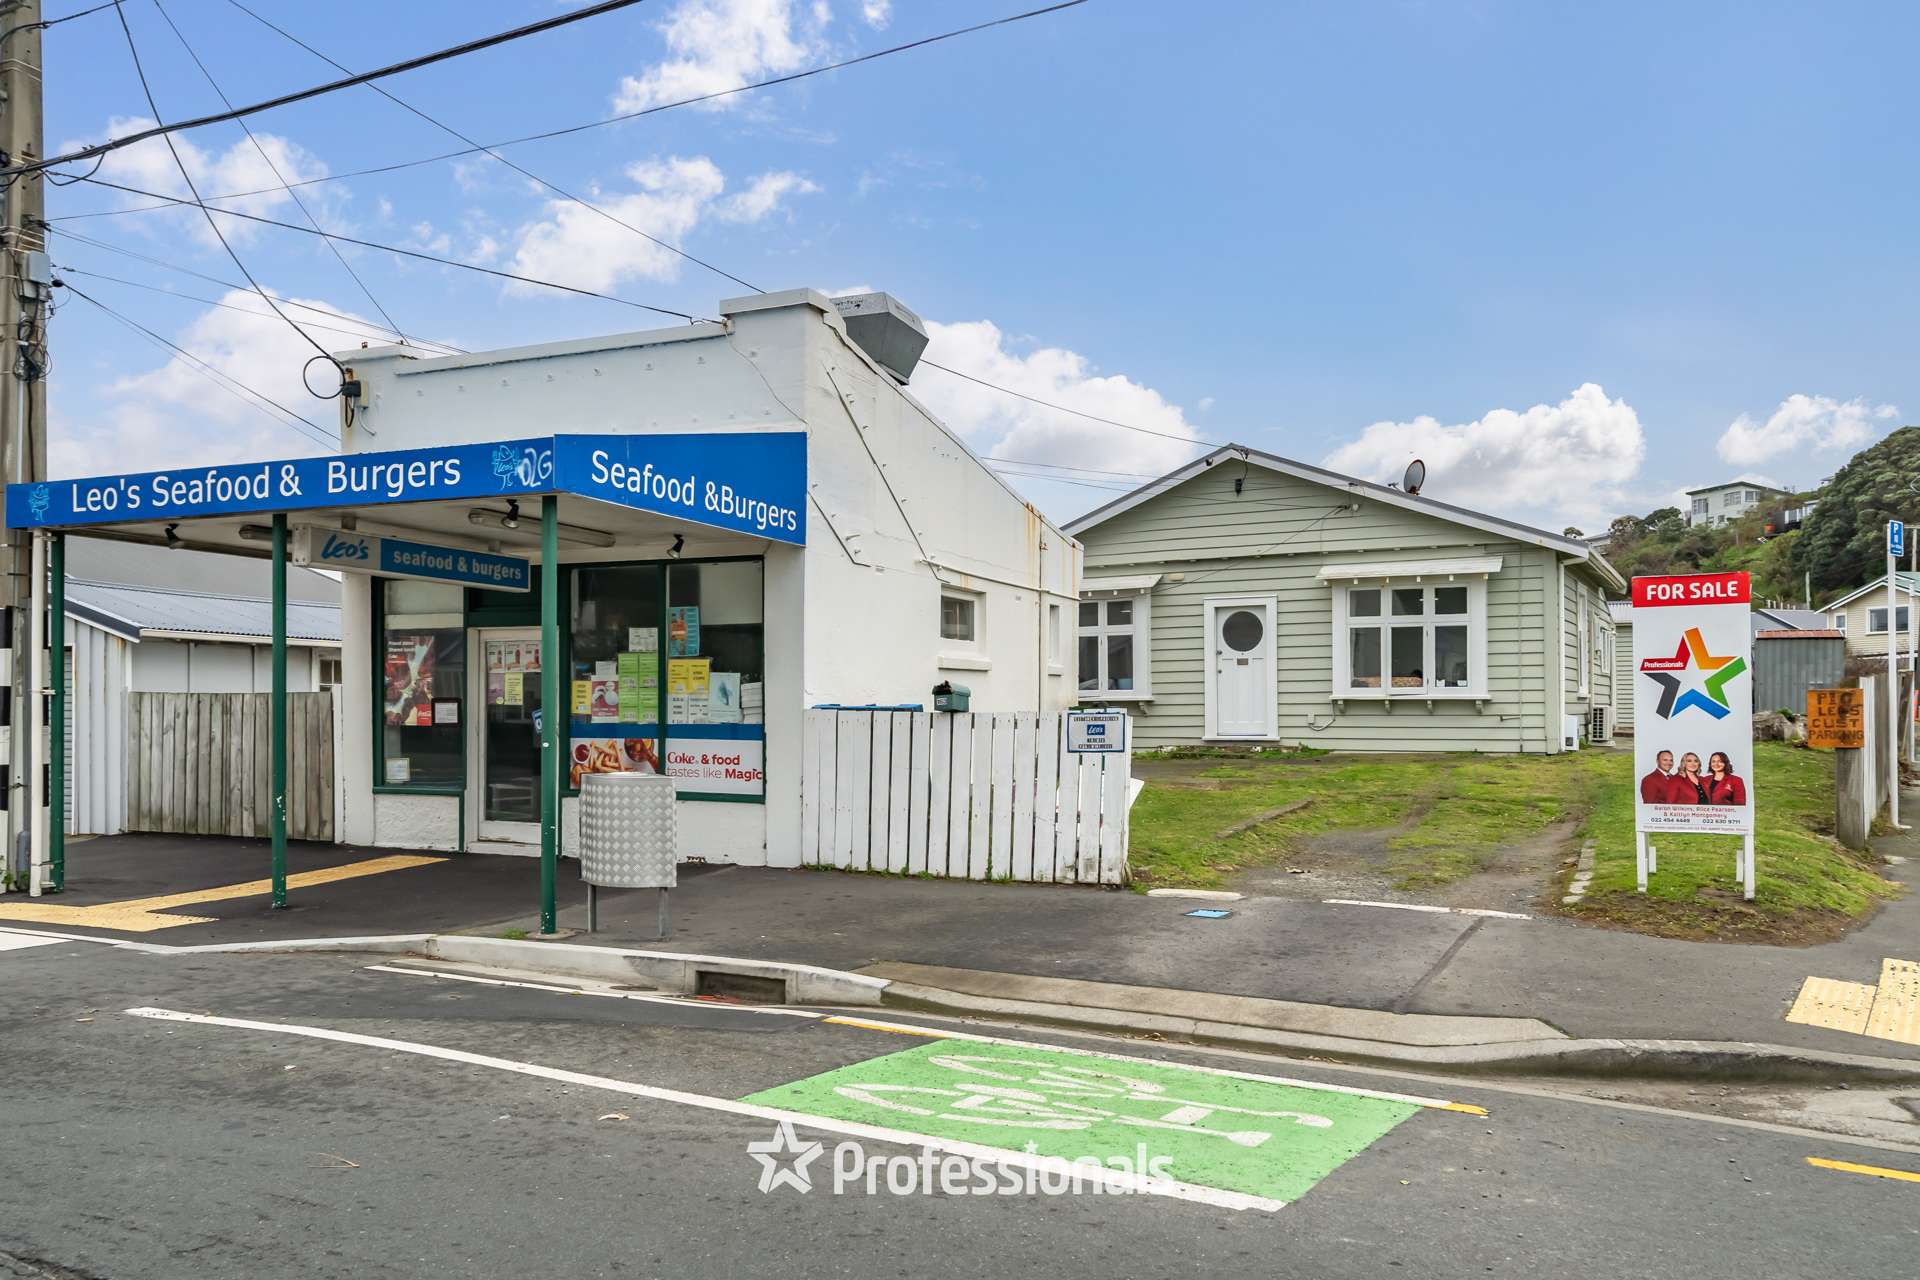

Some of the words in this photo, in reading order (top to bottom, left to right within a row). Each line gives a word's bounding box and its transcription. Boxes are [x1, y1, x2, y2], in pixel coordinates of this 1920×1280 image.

[72, 478, 141, 512] Leo's
[152, 465, 270, 507] Seafood
[279, 464, 302, 497] &
[327, 457, 461, 498] Burgers
[591, 450, 695, 506] Seafood
[704, 480, 797, 531] &Burgers
[321, 534, 369, 560] Leo's
[393, 550, 452, 571] seafood
[457, 555, 468, 573] &
[472, 558, 522, 580] burgers
[1646, 583, 1685, 600] FOR
[1689, 580, 1739, 599] SALE
[1643, 660, 1684, 668] Professionals
[667, 751, 695, 764] Coke
[701, 753, 710, 765] &
[712, 754, 740, 765] food
[667, 767, 700, 778] tastes
[704, 767, 721, 778] like
[725, 768, 763, 782] Magic
